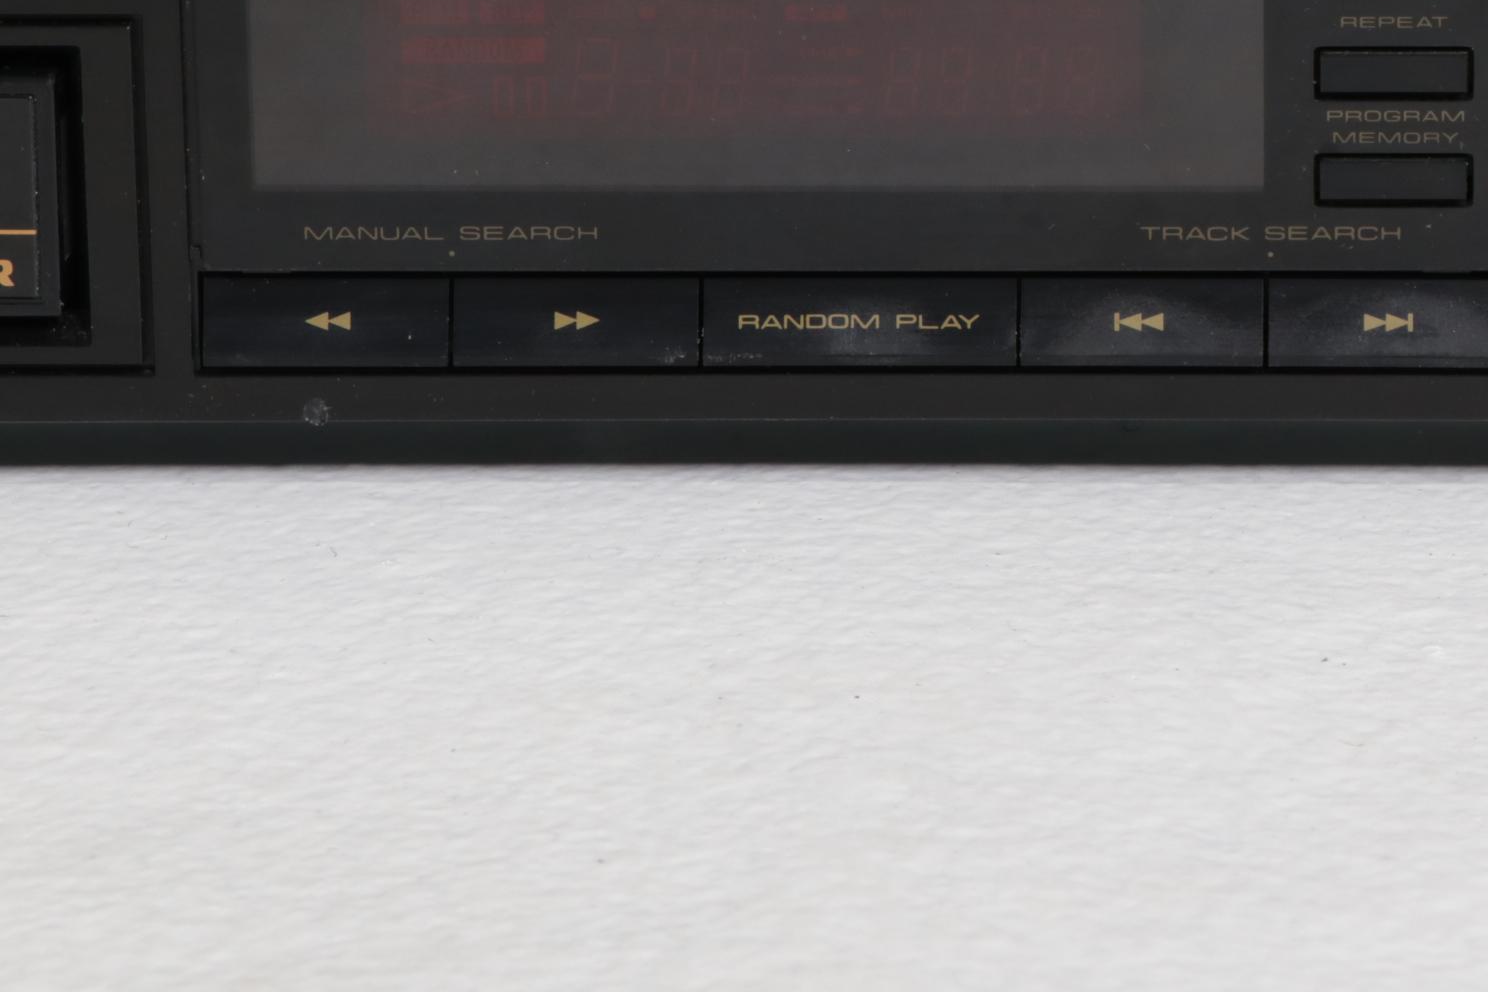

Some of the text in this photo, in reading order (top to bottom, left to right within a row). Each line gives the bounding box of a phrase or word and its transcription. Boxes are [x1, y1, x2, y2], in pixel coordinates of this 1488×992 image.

[1340, 15, 1449, 29] REPEAT
[1326, 109, 1465, 123] PROGRAM
[1332, 131, 1459, 145] MEMORY
[303, 225, 598, 241] MANUAL SEARCH
[1140, 225, 1401, 242] TRACK SEARCH
[738, 313, 980, 330] RANDOM PLAY
